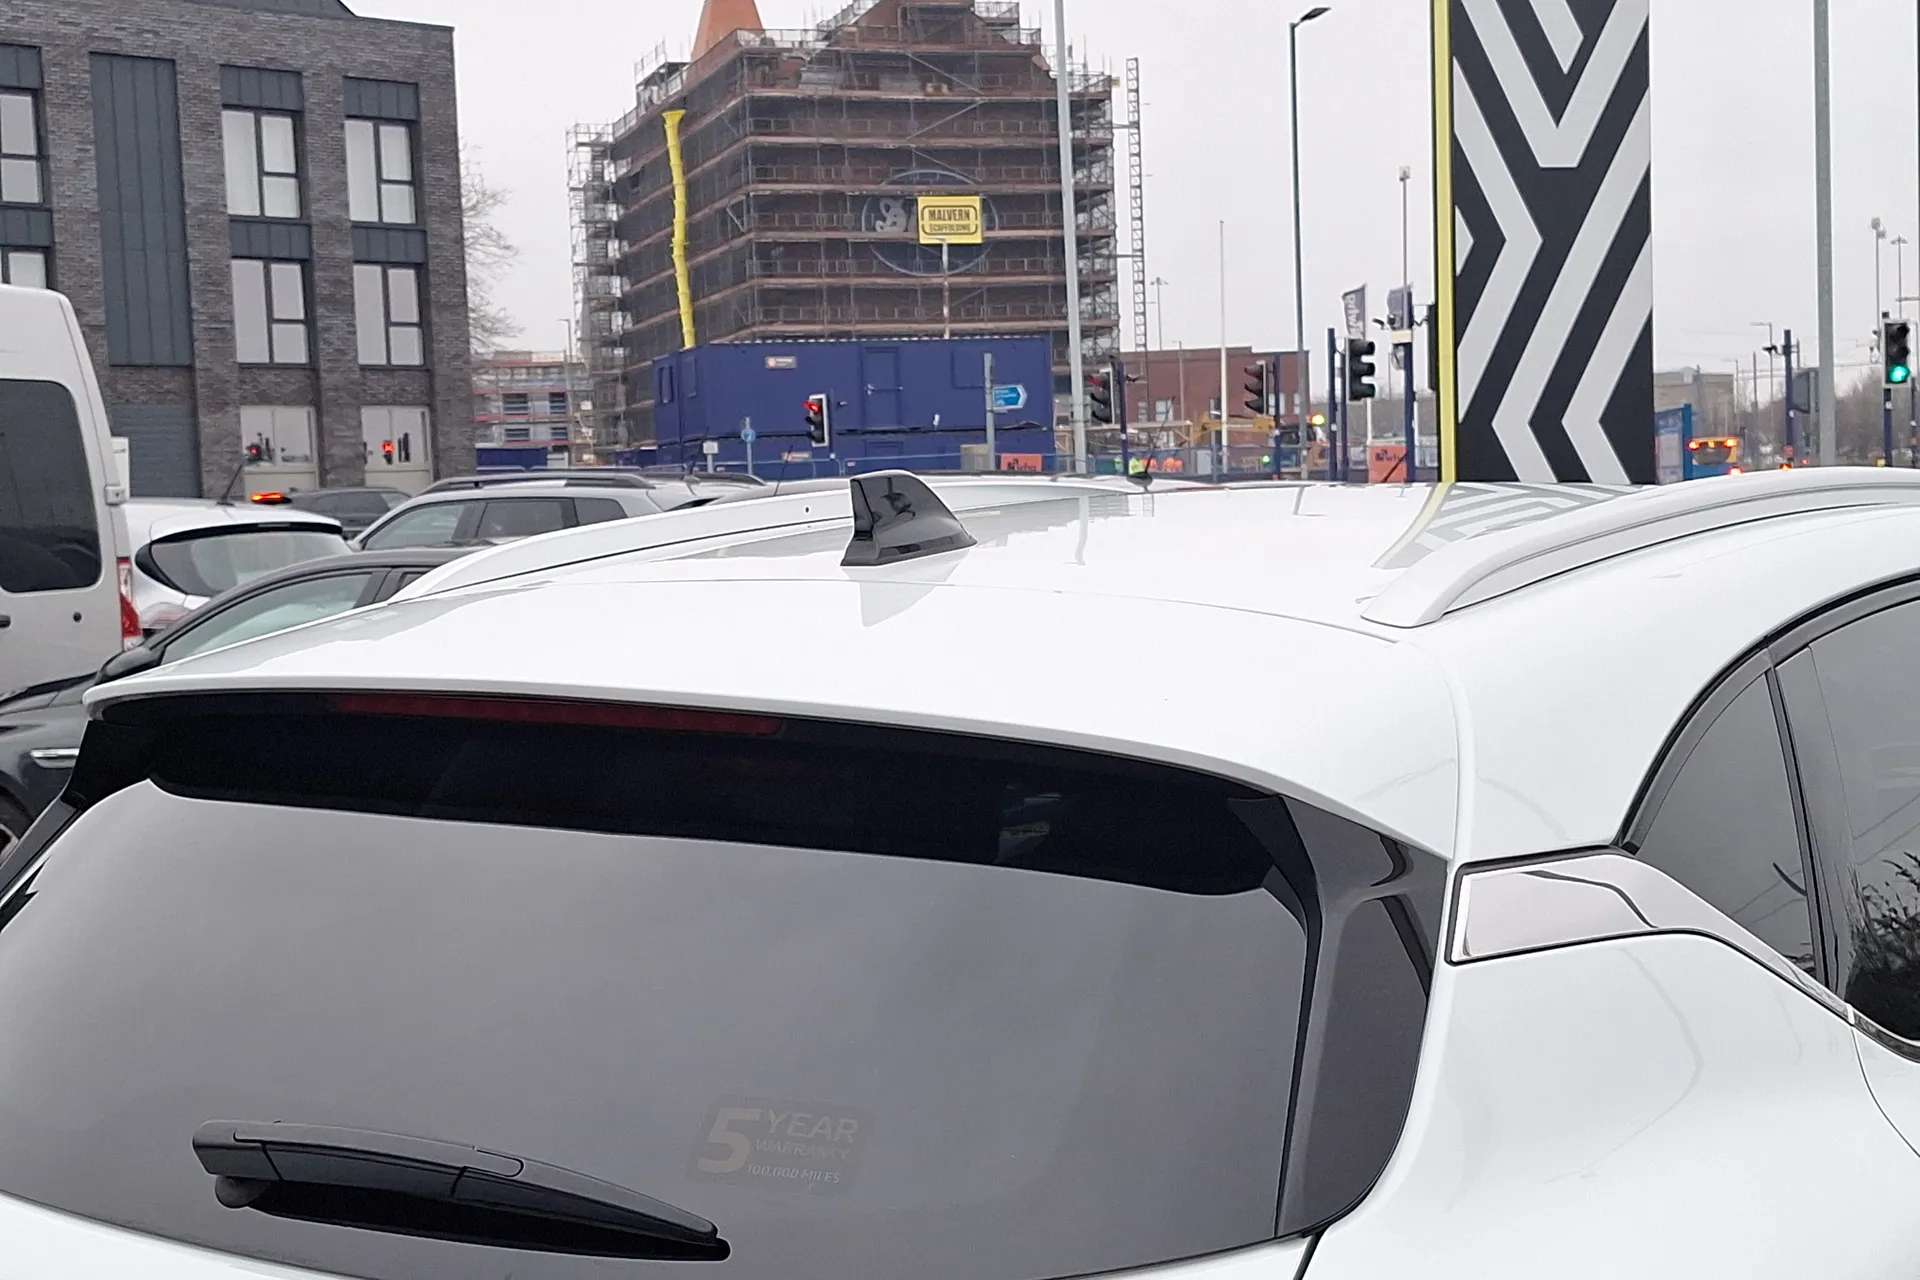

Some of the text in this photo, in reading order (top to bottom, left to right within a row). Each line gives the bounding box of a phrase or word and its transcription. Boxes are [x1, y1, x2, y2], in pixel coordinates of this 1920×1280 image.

[928, 209, 970, 221] MALVERN
[697, 1107, 859, 1174] 5 YEAR
